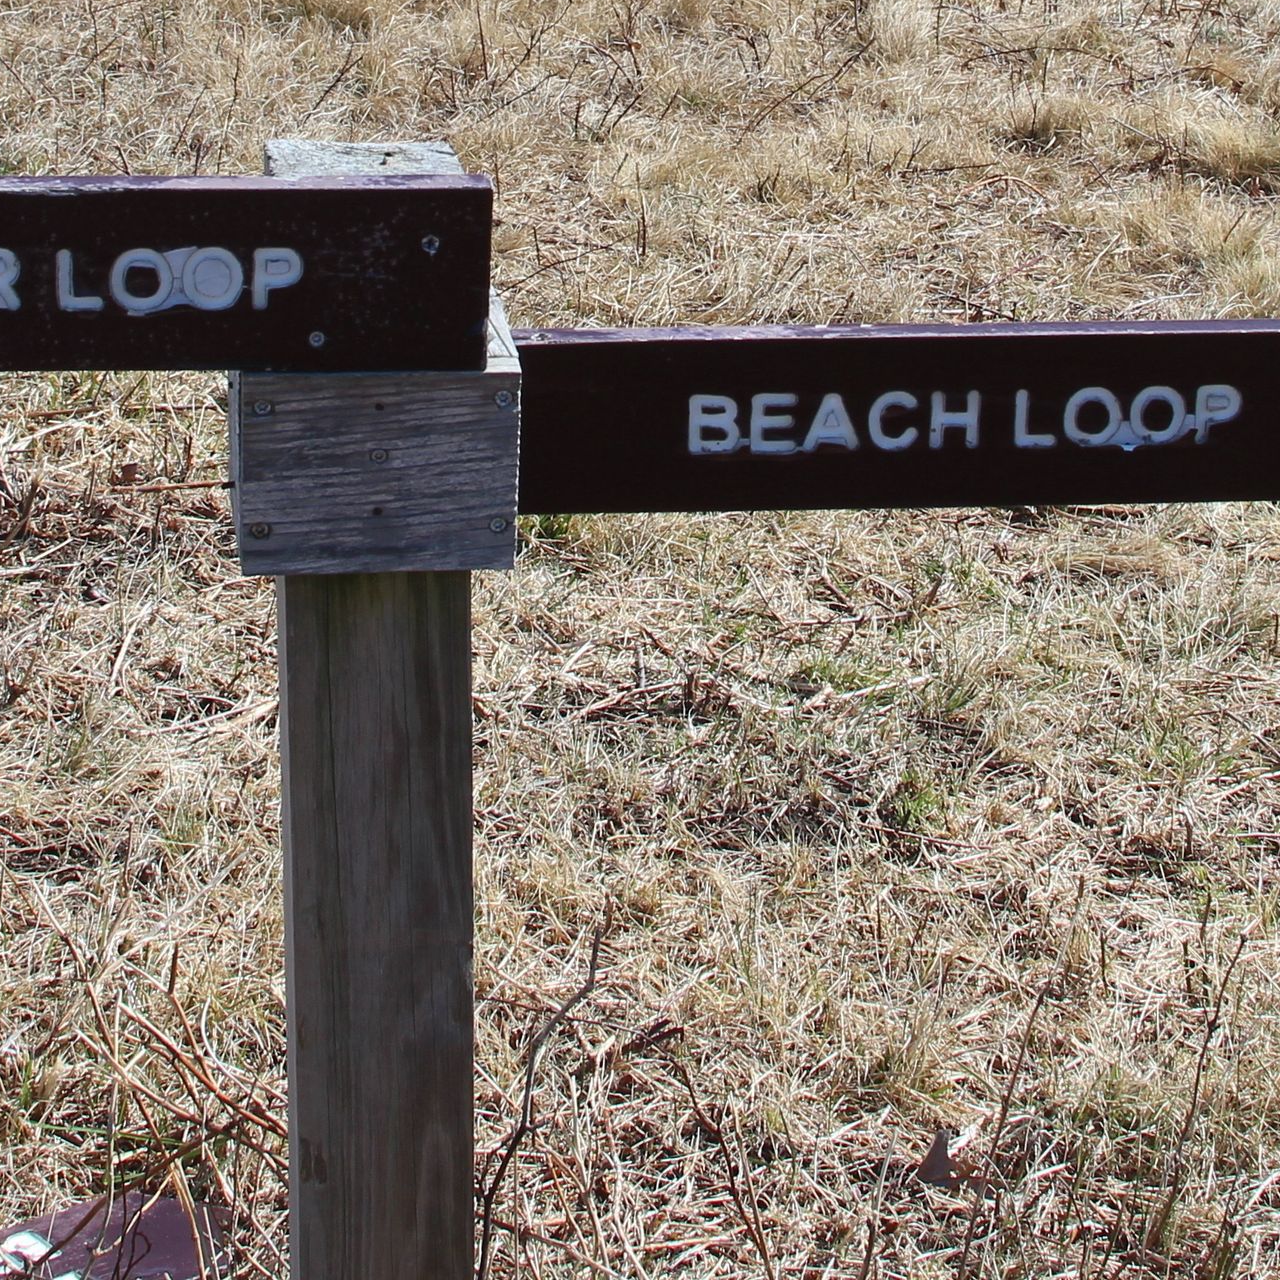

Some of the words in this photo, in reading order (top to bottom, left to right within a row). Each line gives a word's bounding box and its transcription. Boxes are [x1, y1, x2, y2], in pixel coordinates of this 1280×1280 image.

[56, 246, 304, 314] LOOP
[687, 390, 981, 454] BEACH
[1013, 384, 1243, 451] LOOP
